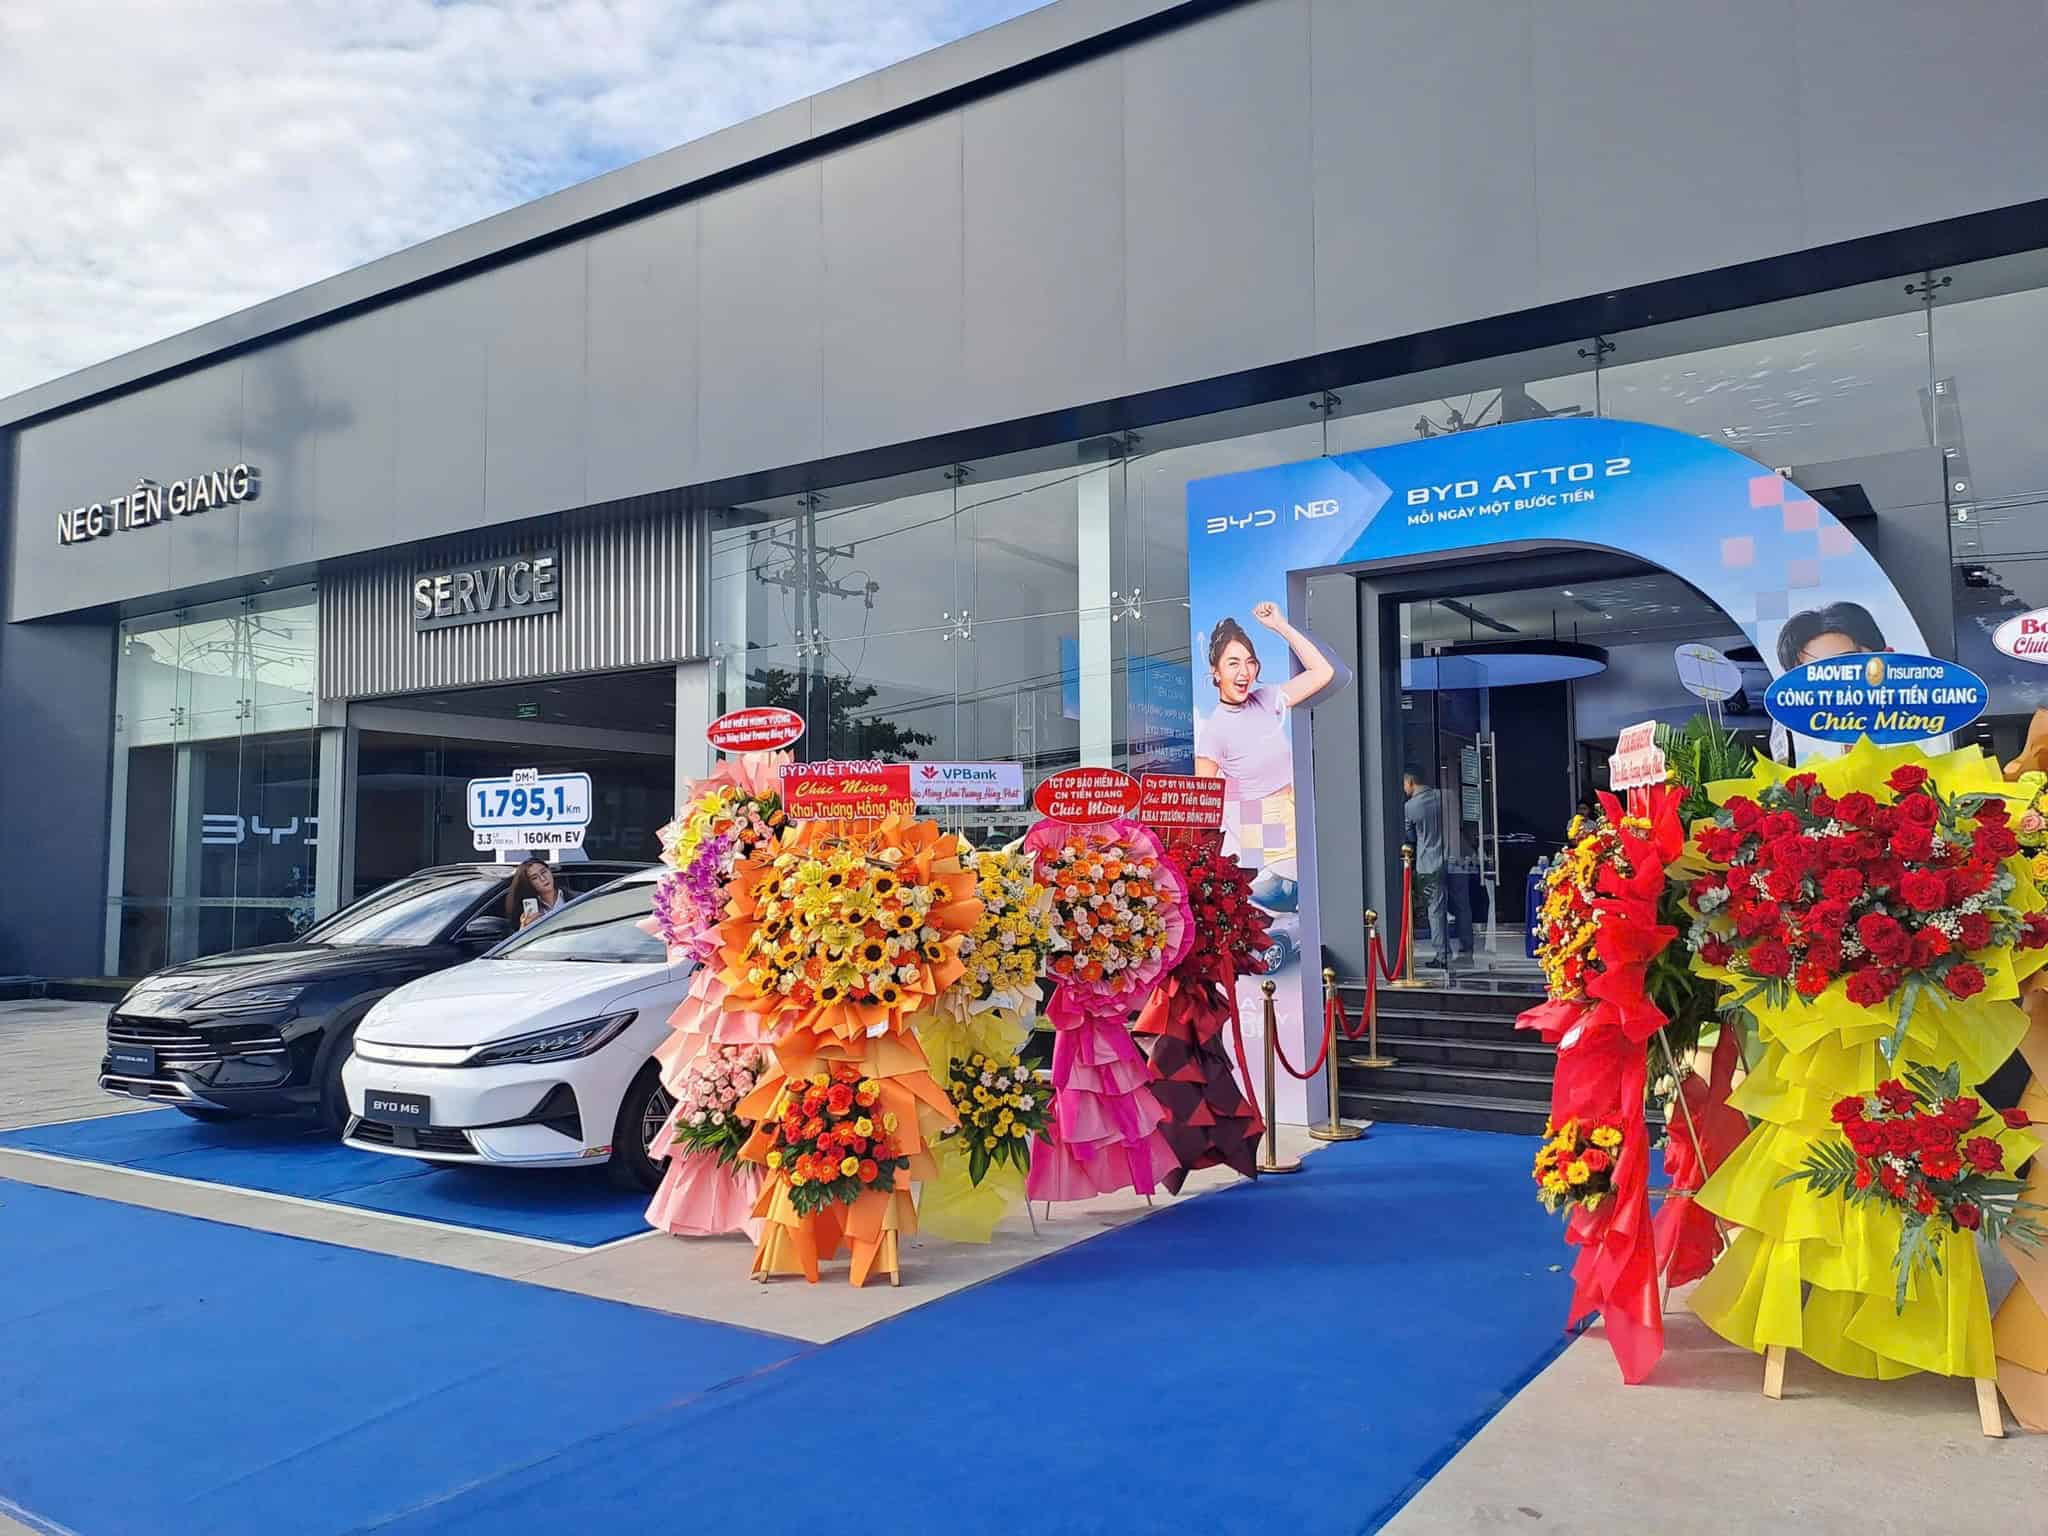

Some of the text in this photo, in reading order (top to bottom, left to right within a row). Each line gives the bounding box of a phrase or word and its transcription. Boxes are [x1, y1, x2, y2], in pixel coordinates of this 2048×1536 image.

[1407, 457, 1632, 506] BYD ATTO 2
[58, 463, 249, 544] NEG TIỀN GIANG
[1407, 488, 1595, 526] MỖI NGÀY MỘT BƯỚC TIẾN
[1207, 499, 1339, 534] BYD NEG
[415, 557, 553, 619] SERVICE
[1807, 664, 1944, 681] BAOVIET Insurance
[1777, 686, 1815, 706] CÔNG
[1817, 689, 1833, 706] TY
[1836, 685, 1863, 705] BẢO
[1866, 686, 1893, 708] VIỆT
[1931, 687, 1977, 704] GIANG
[1809, 710, 1946, 733] Chúc Mừng
[780, 760, 883, 777] BYD VIỆT NAM
[942, 768, 997, 780] VPBank
[795, 780, 835, 798] Chúc
[1049, 777, 1064, 789] TCT
[1065, 777, 1076, 789] CP
[477, 786, 581, 821] 1.795,1 Km
[1055, 791, 1068, 800] CN
[1094, 790, 1123, 799] GIANG
[1161, 792, 1179, 804] BYD
[1199, 794, 1221, 808] Giang
[790, 797, 915, 819] Khai Trương Hồng Phát
[1050, 800, 1125, 817] Chúc Mừng
[477, 833, 492, 845] 3.3
[524, 832, 562, 844] 160Km
[565, 831, 582, 842] EV
[373, 1100, 420, 1114] BYD M6
